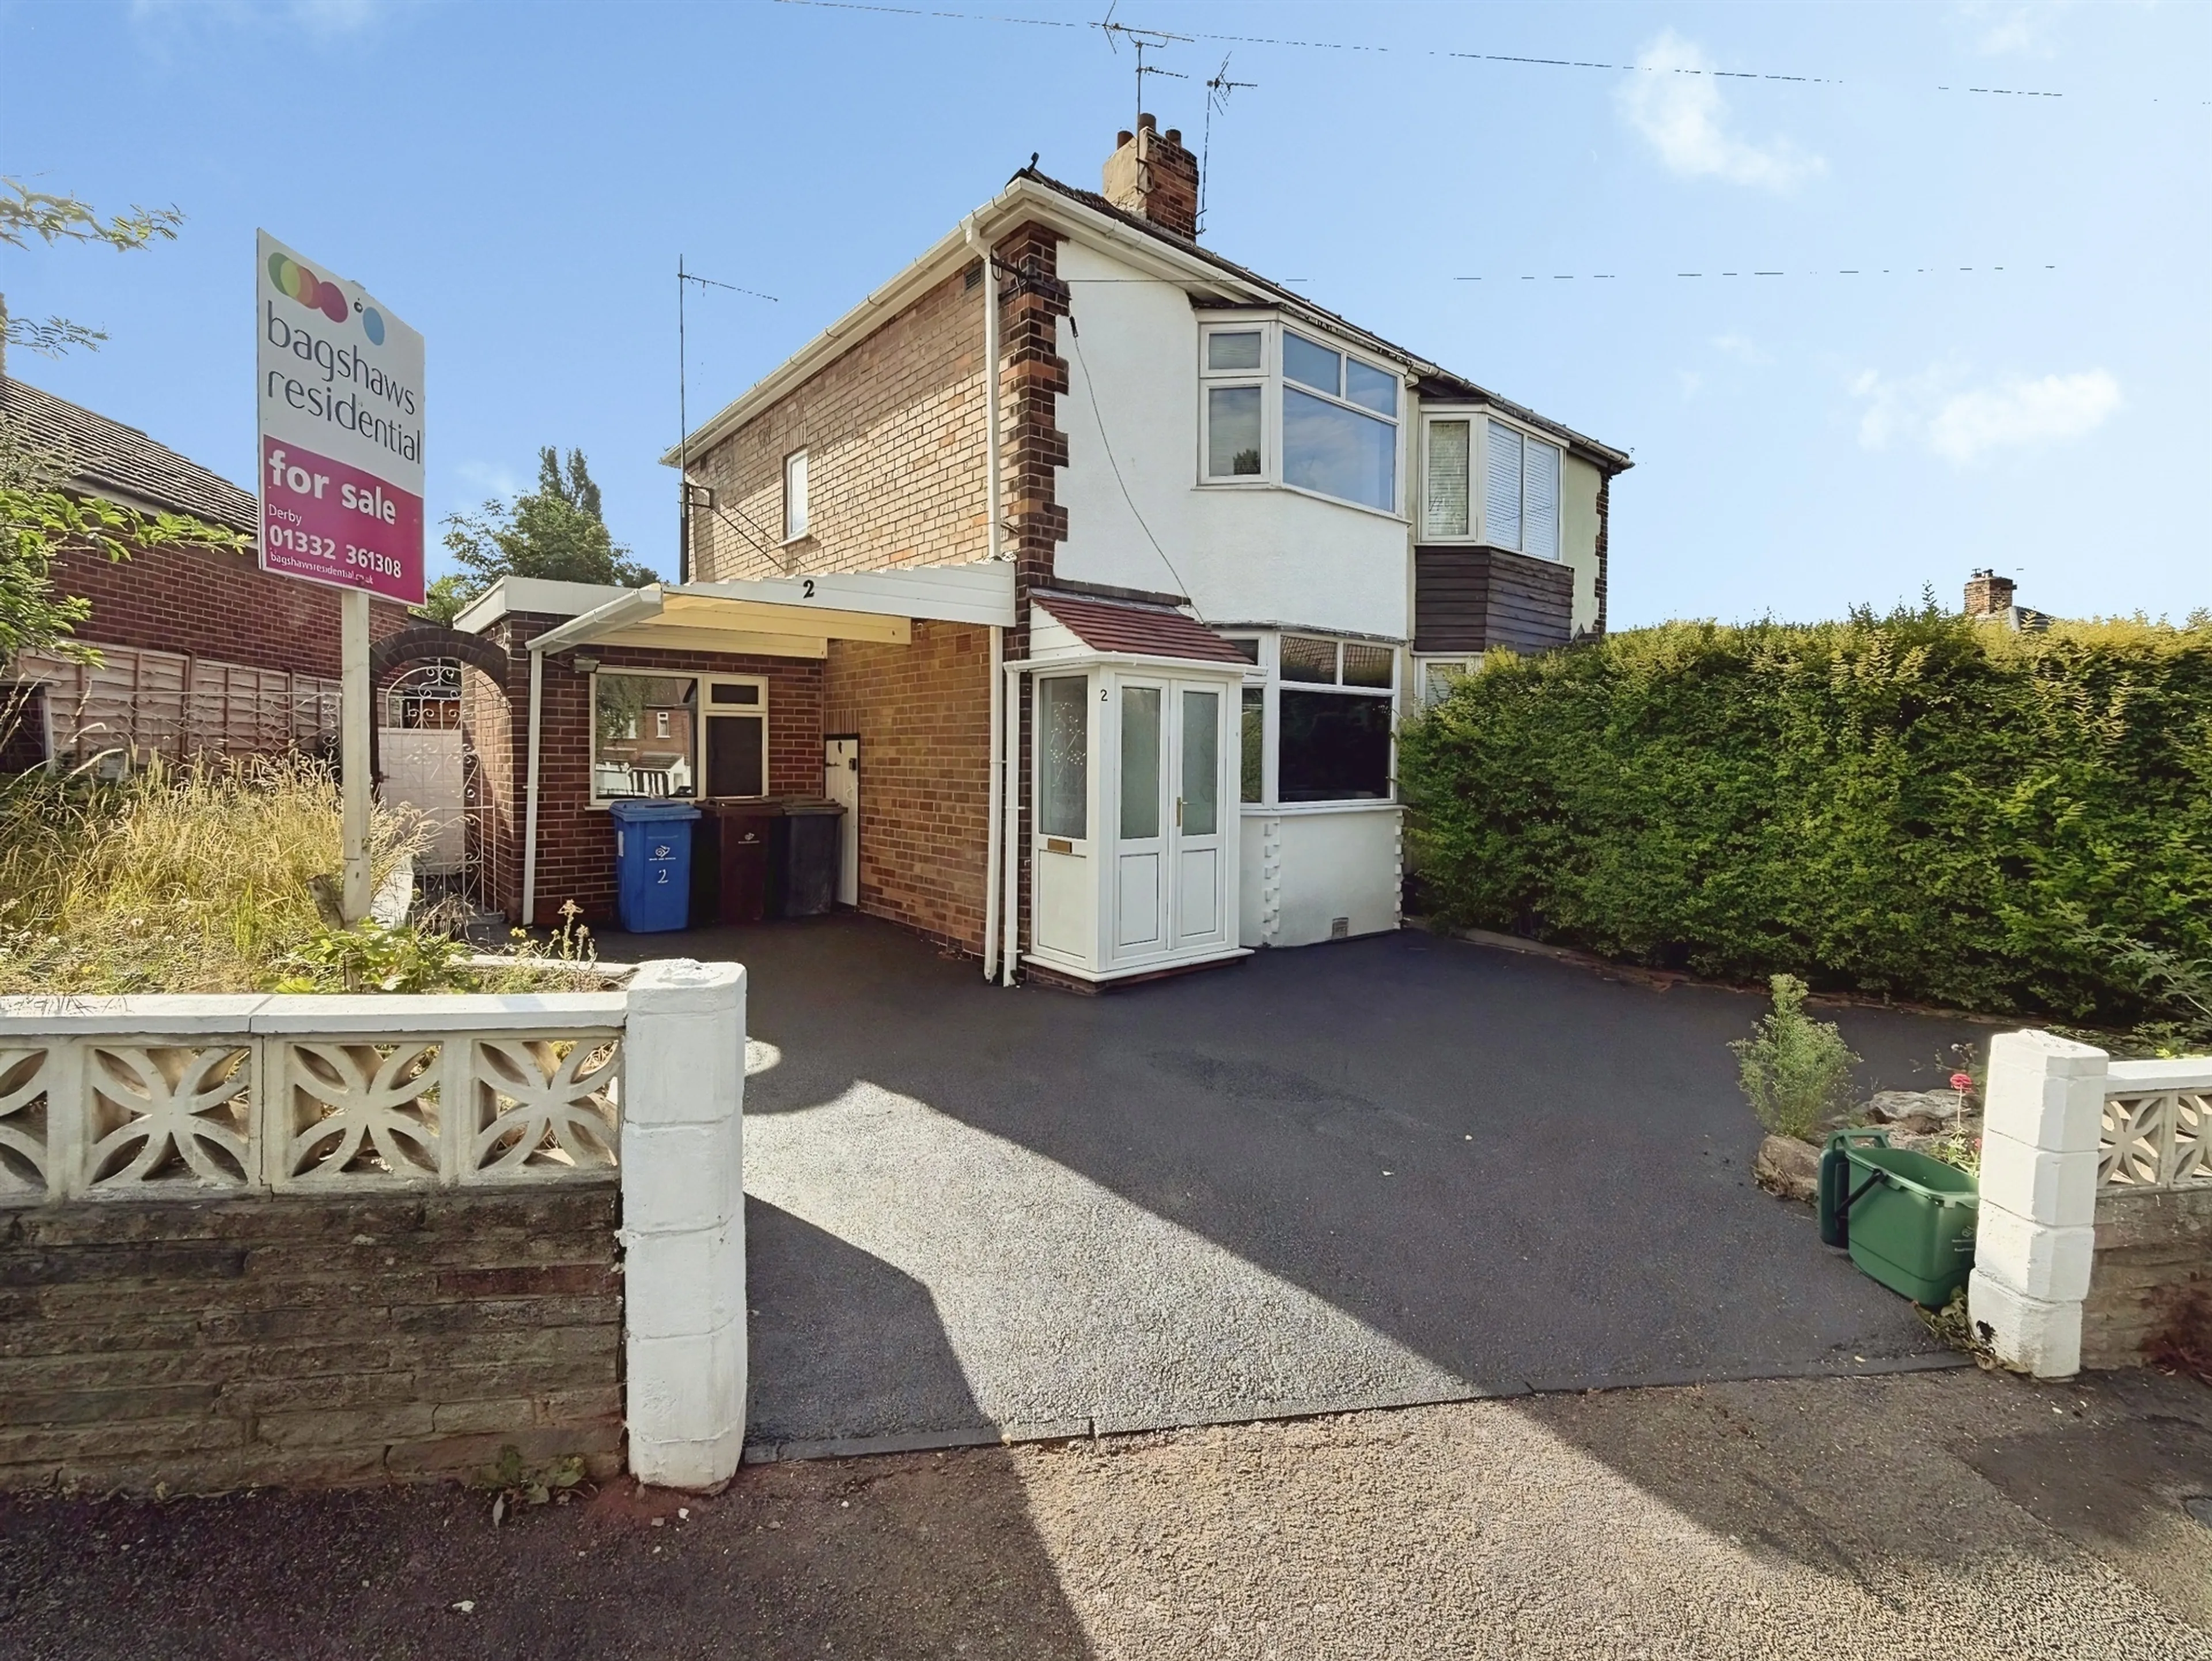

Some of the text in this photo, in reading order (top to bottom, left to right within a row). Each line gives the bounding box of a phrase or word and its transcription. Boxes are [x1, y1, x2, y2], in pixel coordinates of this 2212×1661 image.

[268, 300, 415, 415] bagshaws
[268, 371, 421, 464] residential
[269, 449, 396, 525] for sale
[269, 504, 302, 525] Derby
[270, 525, 402, 578] 01332 361308
[270, 551, 373, 584] bagshawsresidential.couk
[803, 580, 815, 599] 2
[1100, 688, 1108, 702] 2
[657, 869, 669, 883] 2
